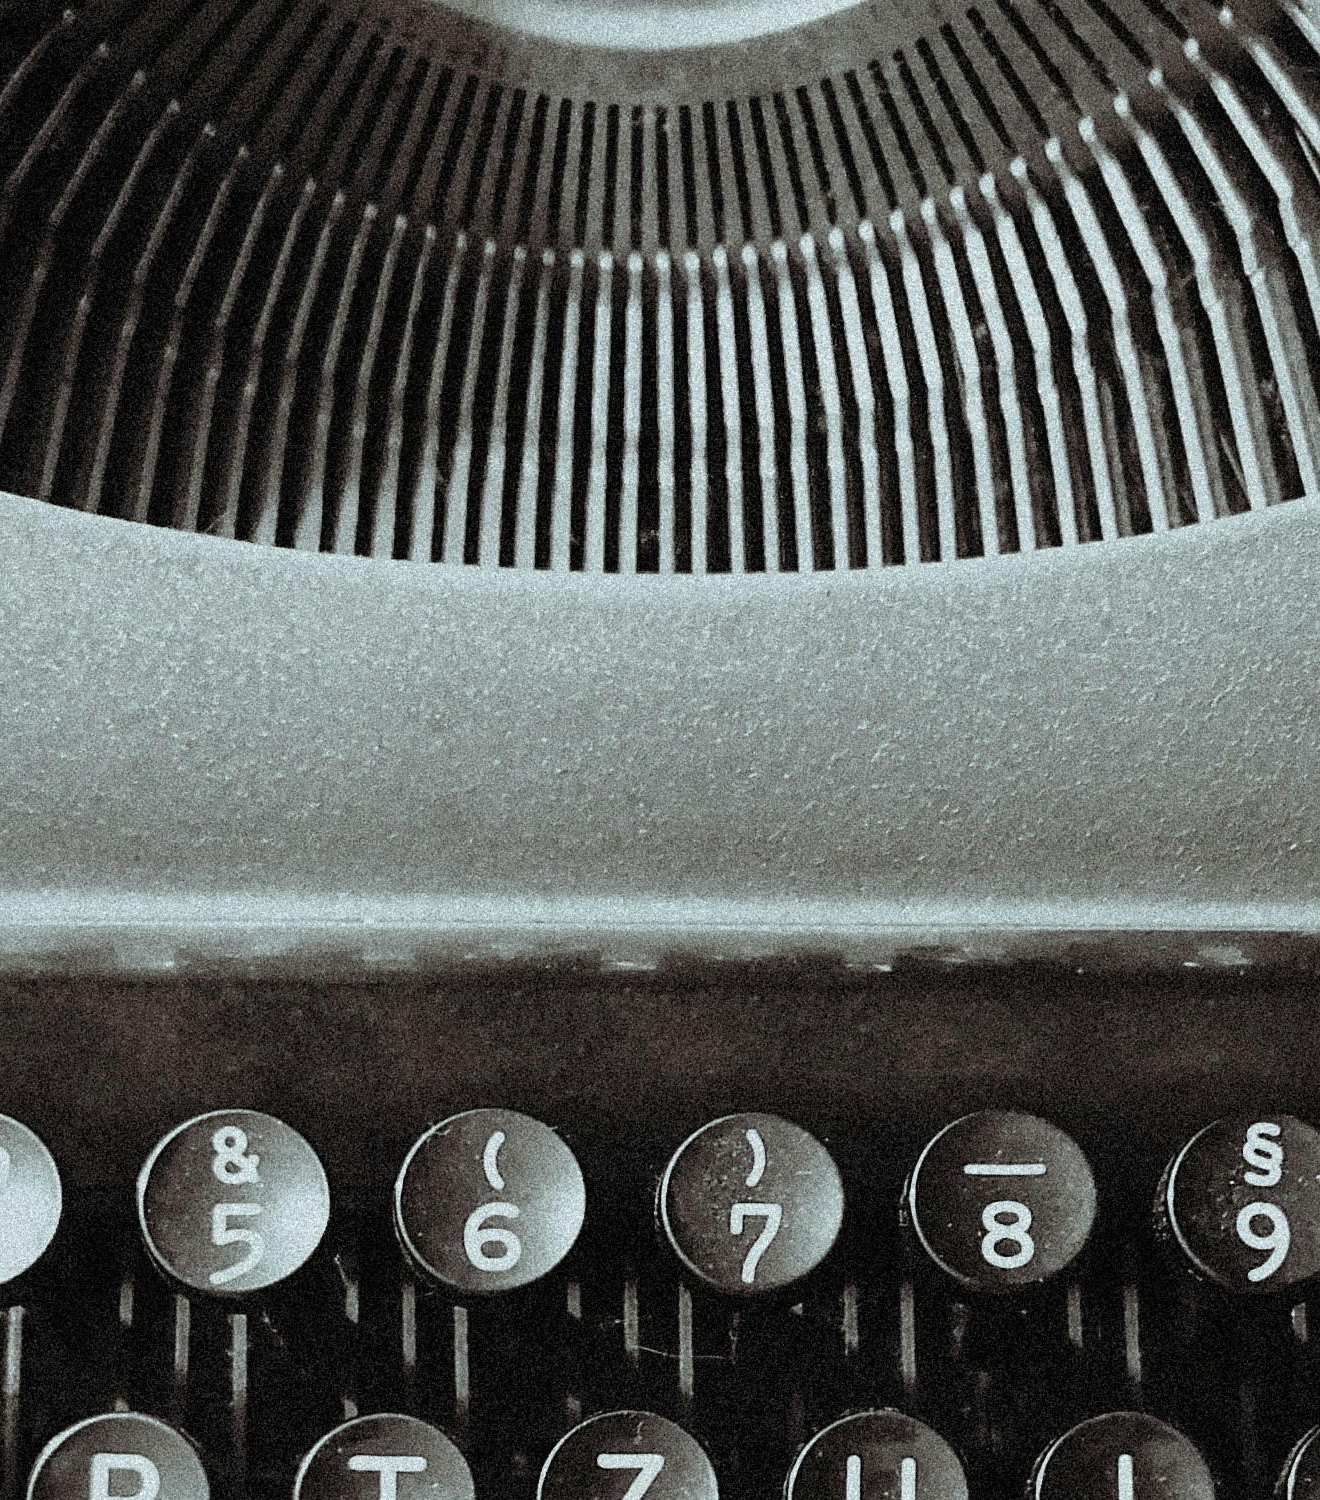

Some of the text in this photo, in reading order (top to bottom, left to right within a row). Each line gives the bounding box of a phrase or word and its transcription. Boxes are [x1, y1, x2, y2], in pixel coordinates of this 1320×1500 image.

[213, 1125, 261, 1184] &
[484, 1131, 505, 1191] (
[746, 1129, 767, 1186] )
[1242, 1122, 1284, 1186] §
[208, 1203, 264, 1285] 5
[464, 1202, 521, 1271] 6
[730, 1203, 782, 1283] 7
[982, 1201, 1035, 1269] 8
[1236, 1202, 1290, 1282] 9
